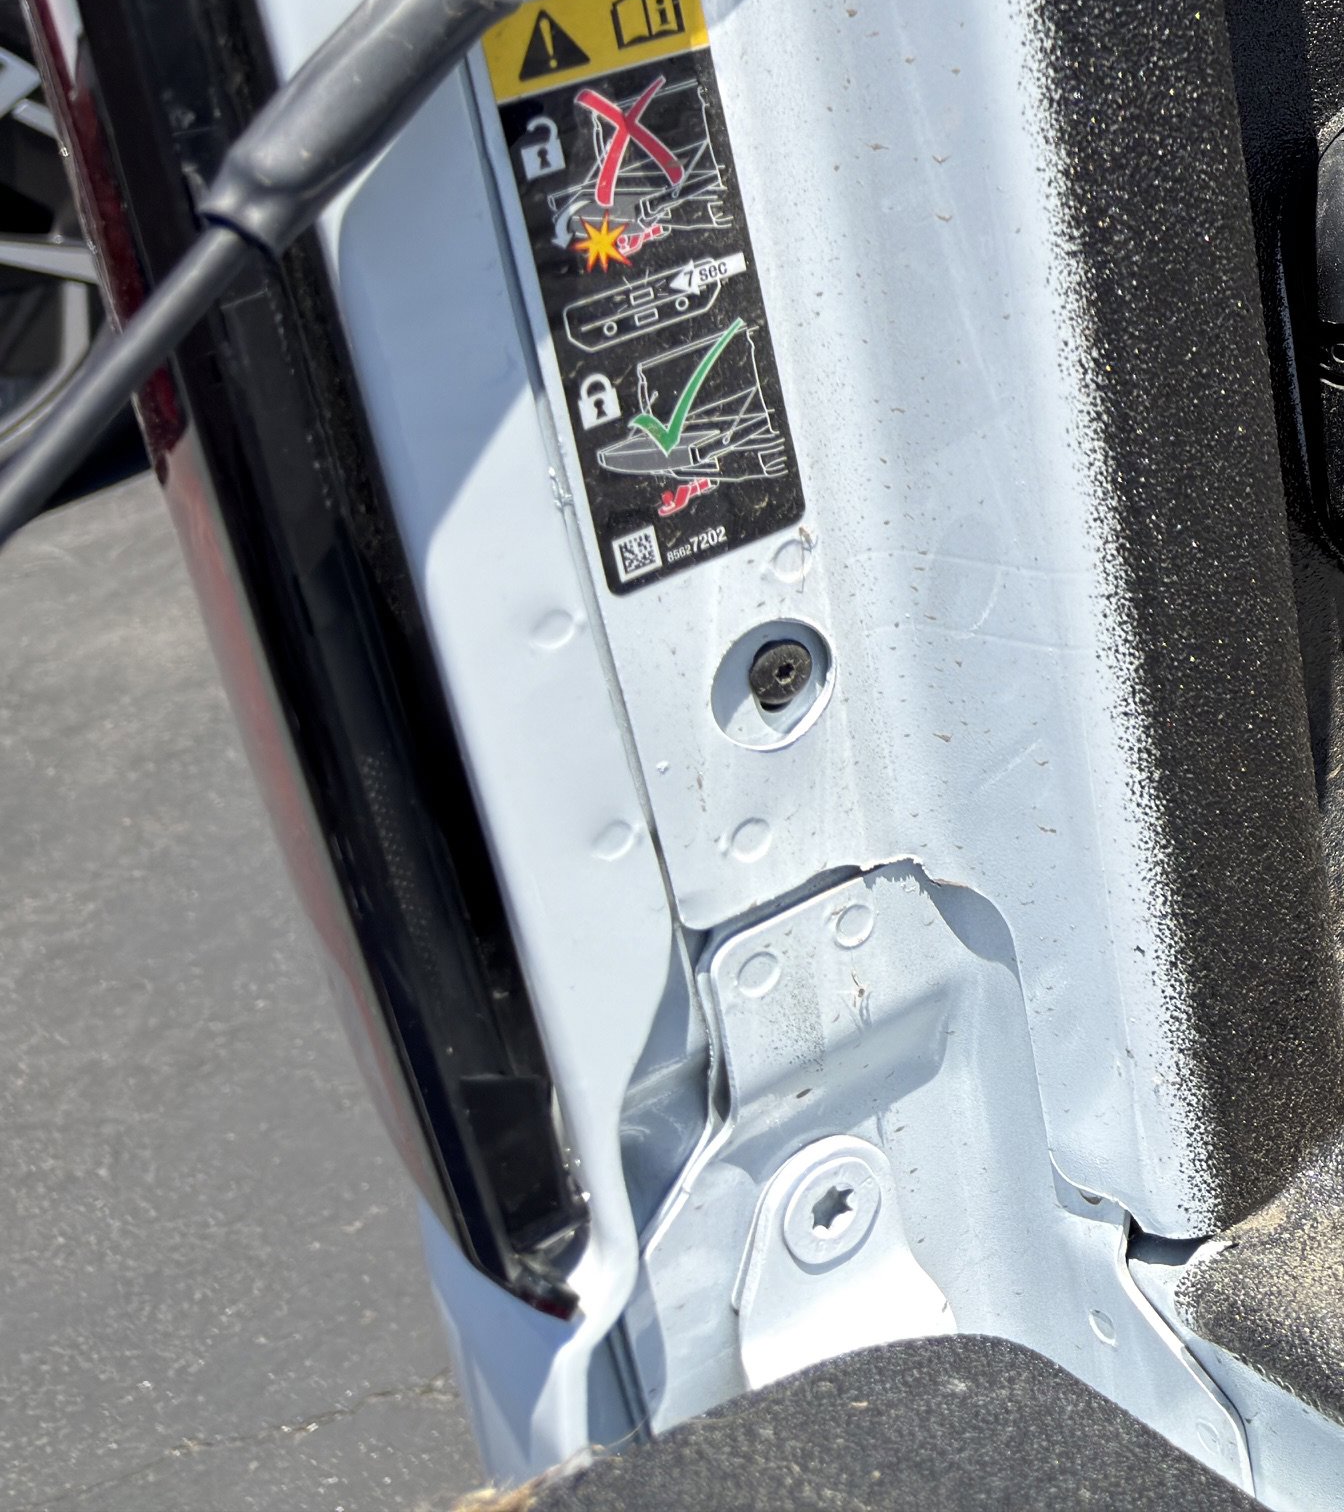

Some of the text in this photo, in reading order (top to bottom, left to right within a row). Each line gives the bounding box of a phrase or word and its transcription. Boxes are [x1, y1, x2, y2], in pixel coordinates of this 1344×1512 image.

[683, 261, 728, 289] 7 sec
[666, 525, 728, 563] 85627202
